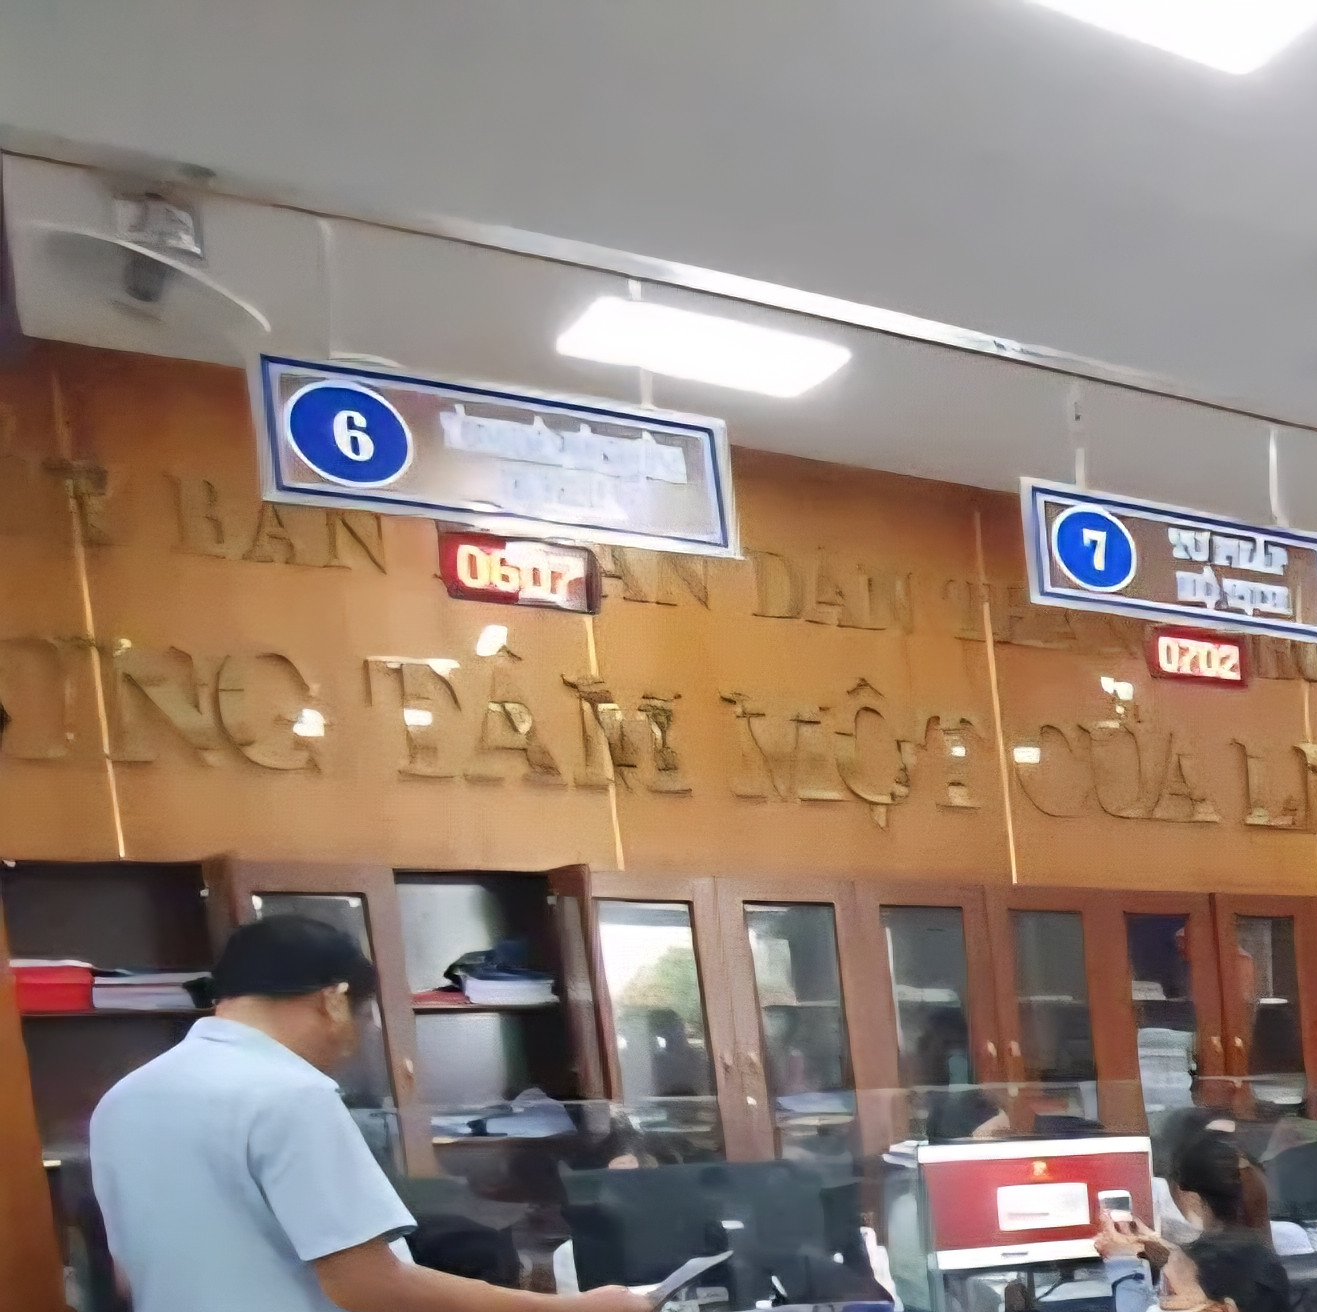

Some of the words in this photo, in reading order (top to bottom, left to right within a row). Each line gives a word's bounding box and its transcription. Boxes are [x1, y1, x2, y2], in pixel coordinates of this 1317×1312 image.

[332, 410, 375, 462] 6
[456, 543, 584, 602] 0607
[1082, 527, 1107, 571] 7
[1158, 636, 1242, 681] 0702
